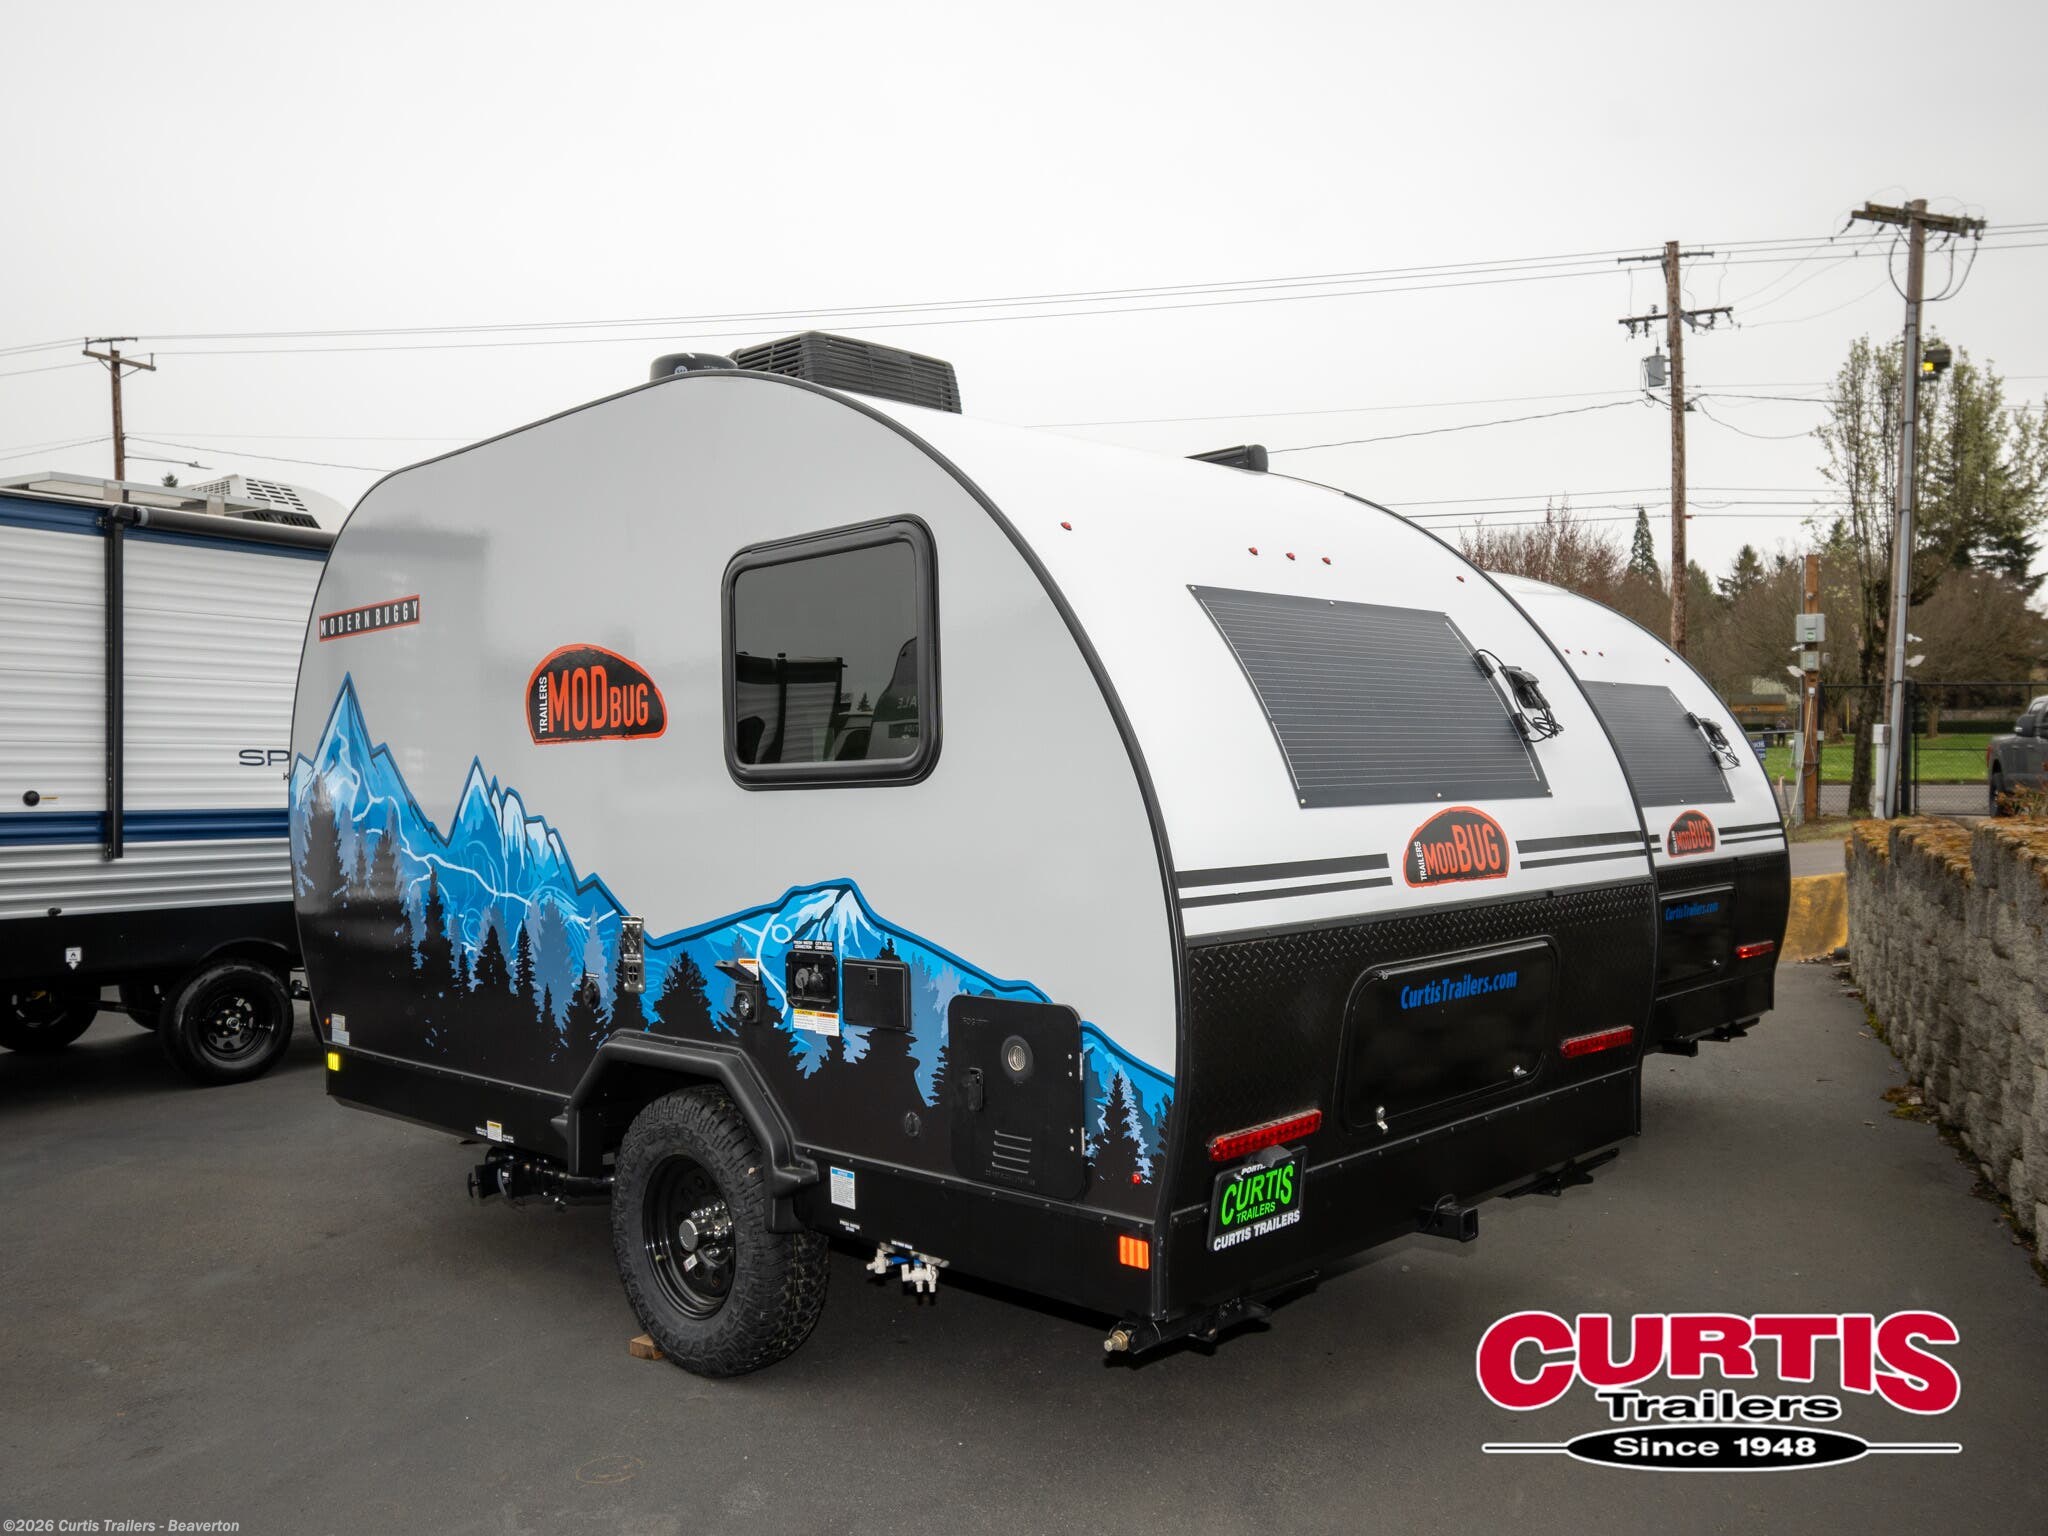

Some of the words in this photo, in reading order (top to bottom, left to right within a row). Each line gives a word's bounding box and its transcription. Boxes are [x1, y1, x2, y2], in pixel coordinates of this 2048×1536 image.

[320, 610, 370, 636] MODERN
[375, 600, 418, 626] BUGGY
[539, 676, 548, 733] TRAILERS
[239, 749, 290, 766] SP
[1414, 841, 1427, 881] TRAILERS
[1400, 970, 1518, 1010] CurtisTrailers.com
[1221, 1164, 1294, 1226] CURTIS
[1236, 1201, 1276, 1224] TRAILERS
[1213, 1227, 1251, 1251] CURTIS
[1253, 1210, 1300, 1237] TRAILERS
